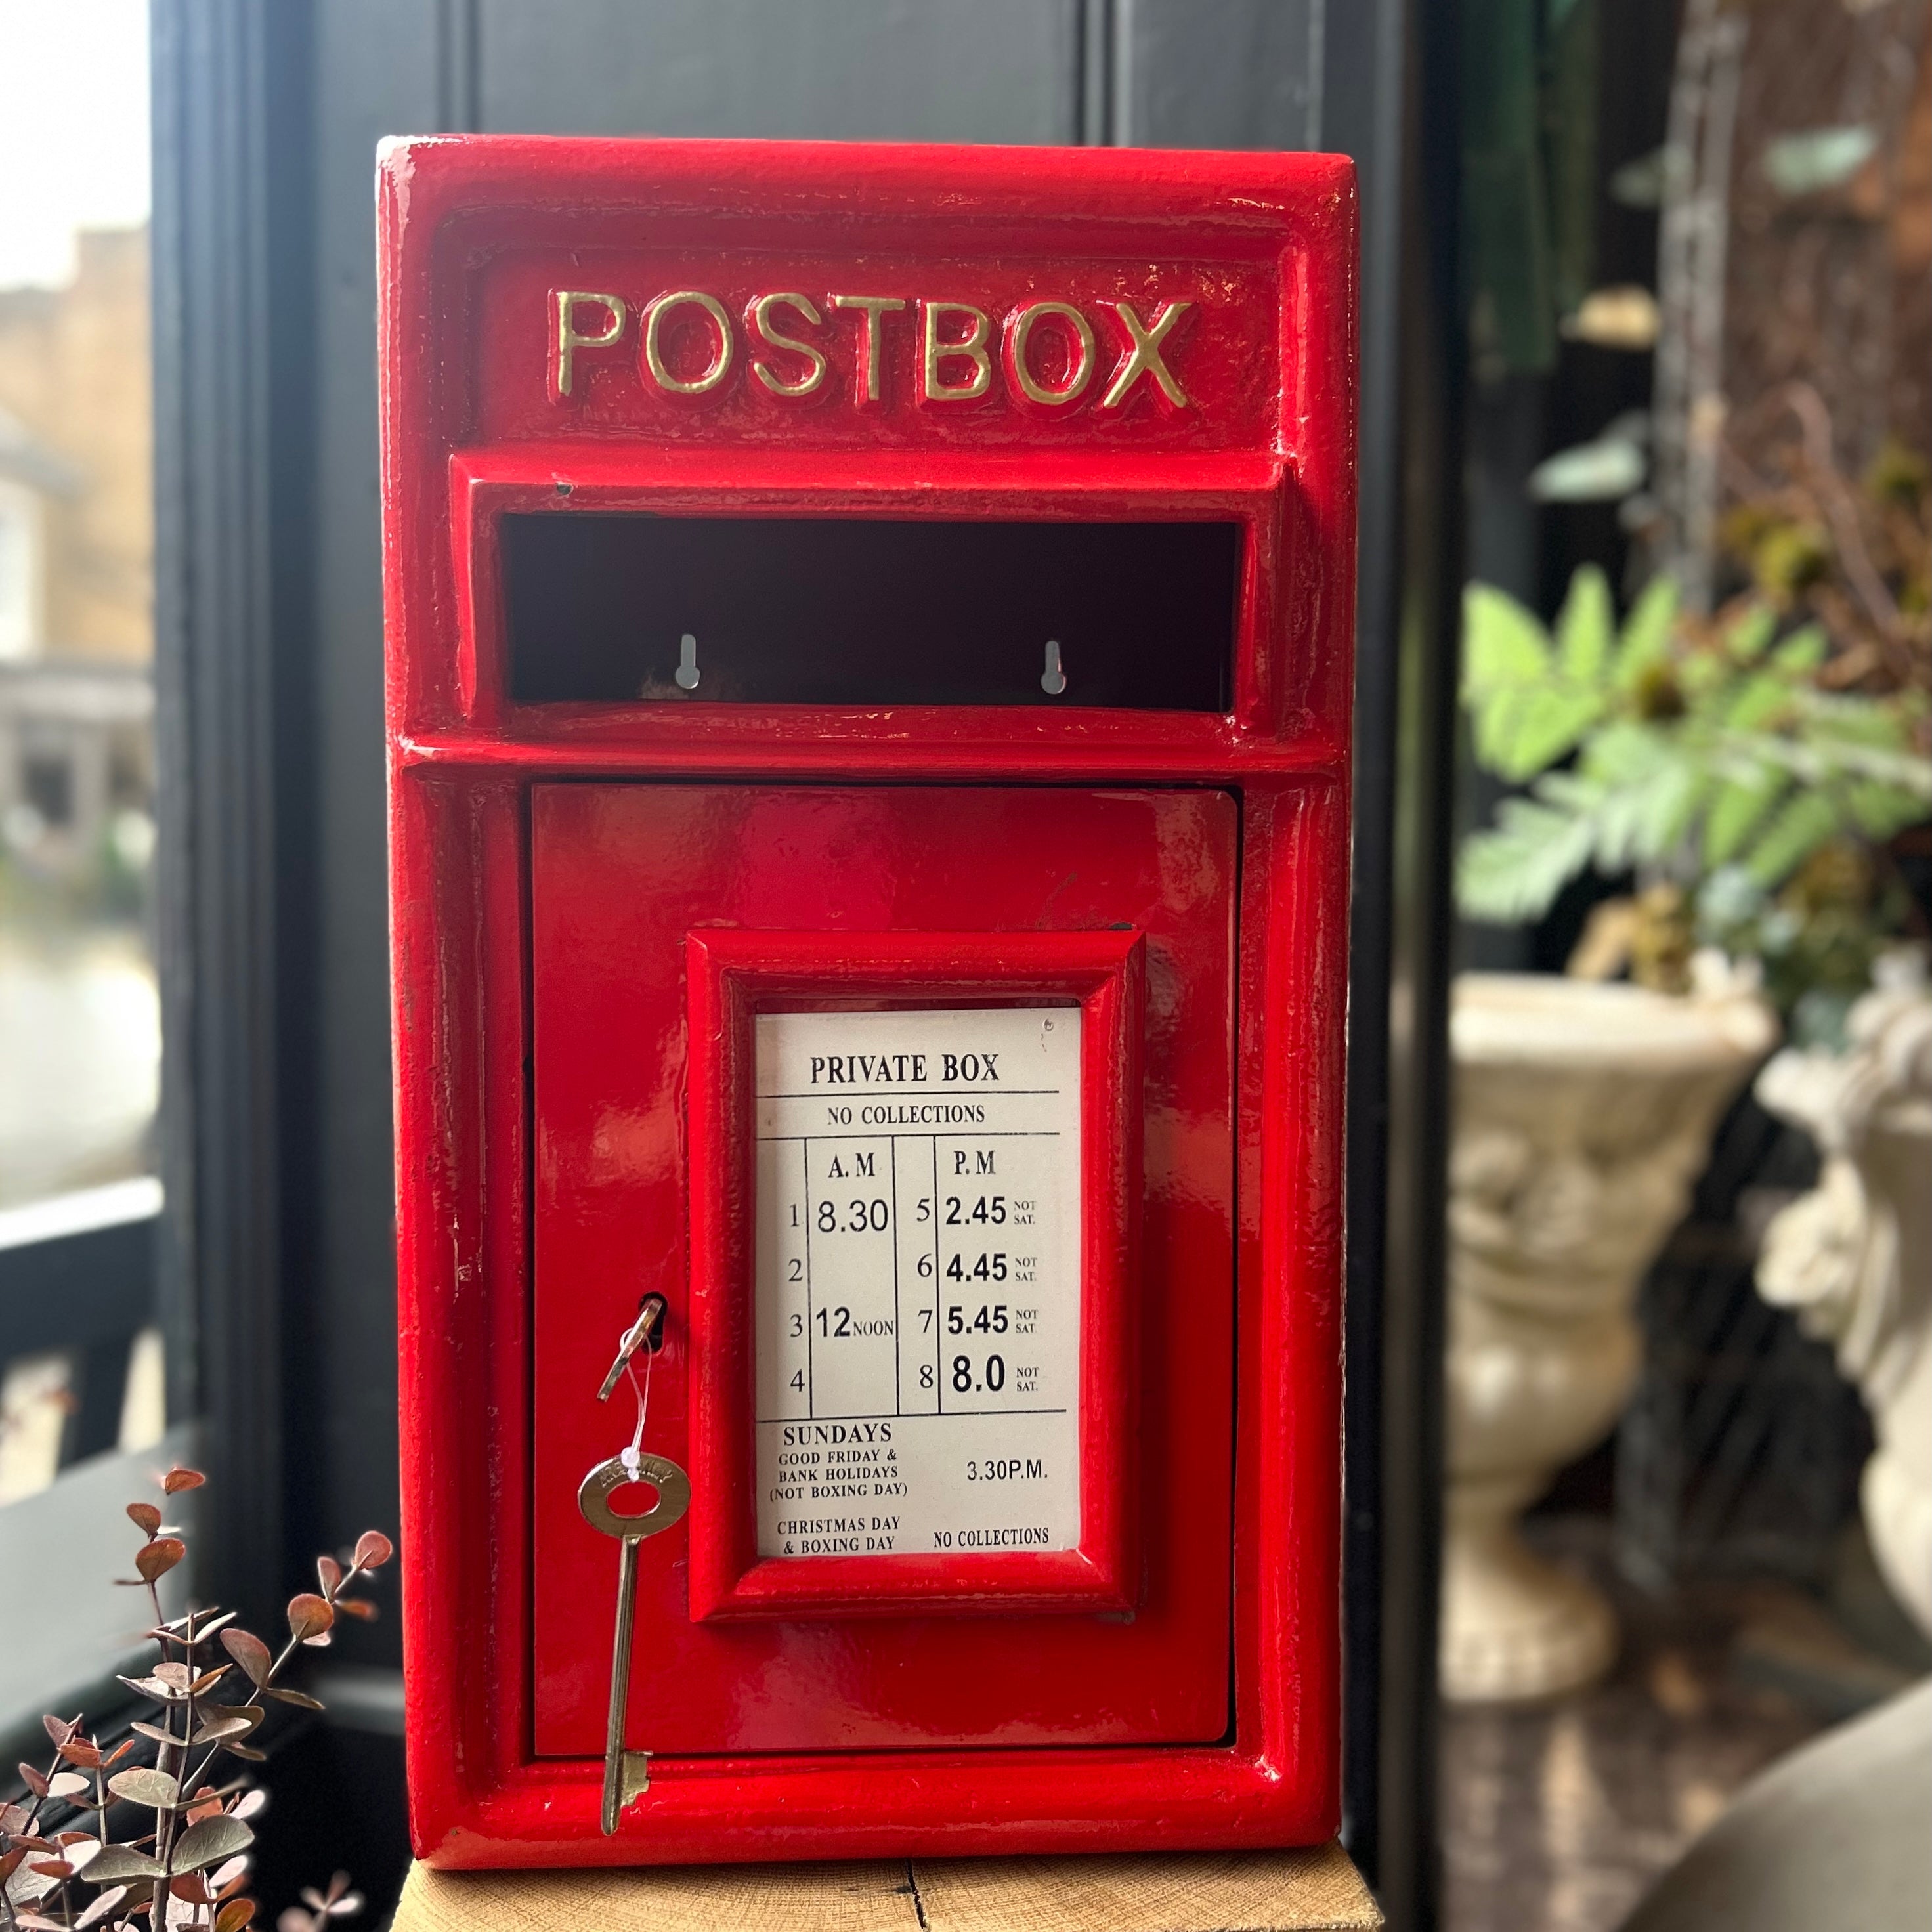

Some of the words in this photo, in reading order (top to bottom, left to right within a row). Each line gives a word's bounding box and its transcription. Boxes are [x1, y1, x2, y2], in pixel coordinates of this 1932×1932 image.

[549, 291, 1191, 410] POSTBOX
[810, 1054, 928, 1084] PRIVATE
[941, 1053, 1000, 1082] BOX
[827, 1106, 853, 1126] NO
[861, 1104, 985, 1125] COLLECTIONS
[789, 1203, 800, 1227] 1
[817, 1198, 889, 1233] 8.30
[916, 1198, 930, 1223] 5
[945, 1195, 1007, 1226] 2.45
[1013, 1200, 1037, 1211] NOT
[1013, 1214, 1036, 1225] SAT.
[788, 1258, 804, 1283] 2
[917, 1253, 933, 1278] 6
[946, 1252, 1008, 1283] 4.45
[1014, 1256, 1037, 1268] NOT
[789, 1314, 803, 1338] 3
[918, 1310, 933, 1333] 7
[947, 1305, 1009, 1335] 5.45
[1016, 1309, 1039, 1320] NOT
[790, 1369, 805, 1392] 4
[920, 1365, 934, 1388] 8
[953, 1354, 1005, 1392] 8.0
[1016, 1367, 1040, 1377] NOT
[1016, 1381, 1039, 1392] SAT.
[783, 1423, 892, 1446] SUNDAYS
[778, 1452, 820, 1465] GOOD
[828, 1449, 880, 1463] FRIDAY
[886, 1448, 897, 1461] &
[779, 1469, 818, 1482] BANK
[826, 1467, 898, 1480] HOLIDAYS
[966, 1459, 1048, 1481] 3.30P.M.
[769, 1486, 804, 1502] (NOT
[811, 1485, 867, 1498] BOXING
[874, 1482, 908, 1497] DAY)
[777, 1518, 865, 1535] CHRISTMAS
[871, 1516, 901, 1531] DAY
[783, 1541, 794, 1554] &
[801, 1538, 859, 1554] BOXING
[866, 1536, 895, 1550] DAY
[933, 1531, 952, 1548] NO
[958, 1528, 1049, 1547] COLLECTIONS
